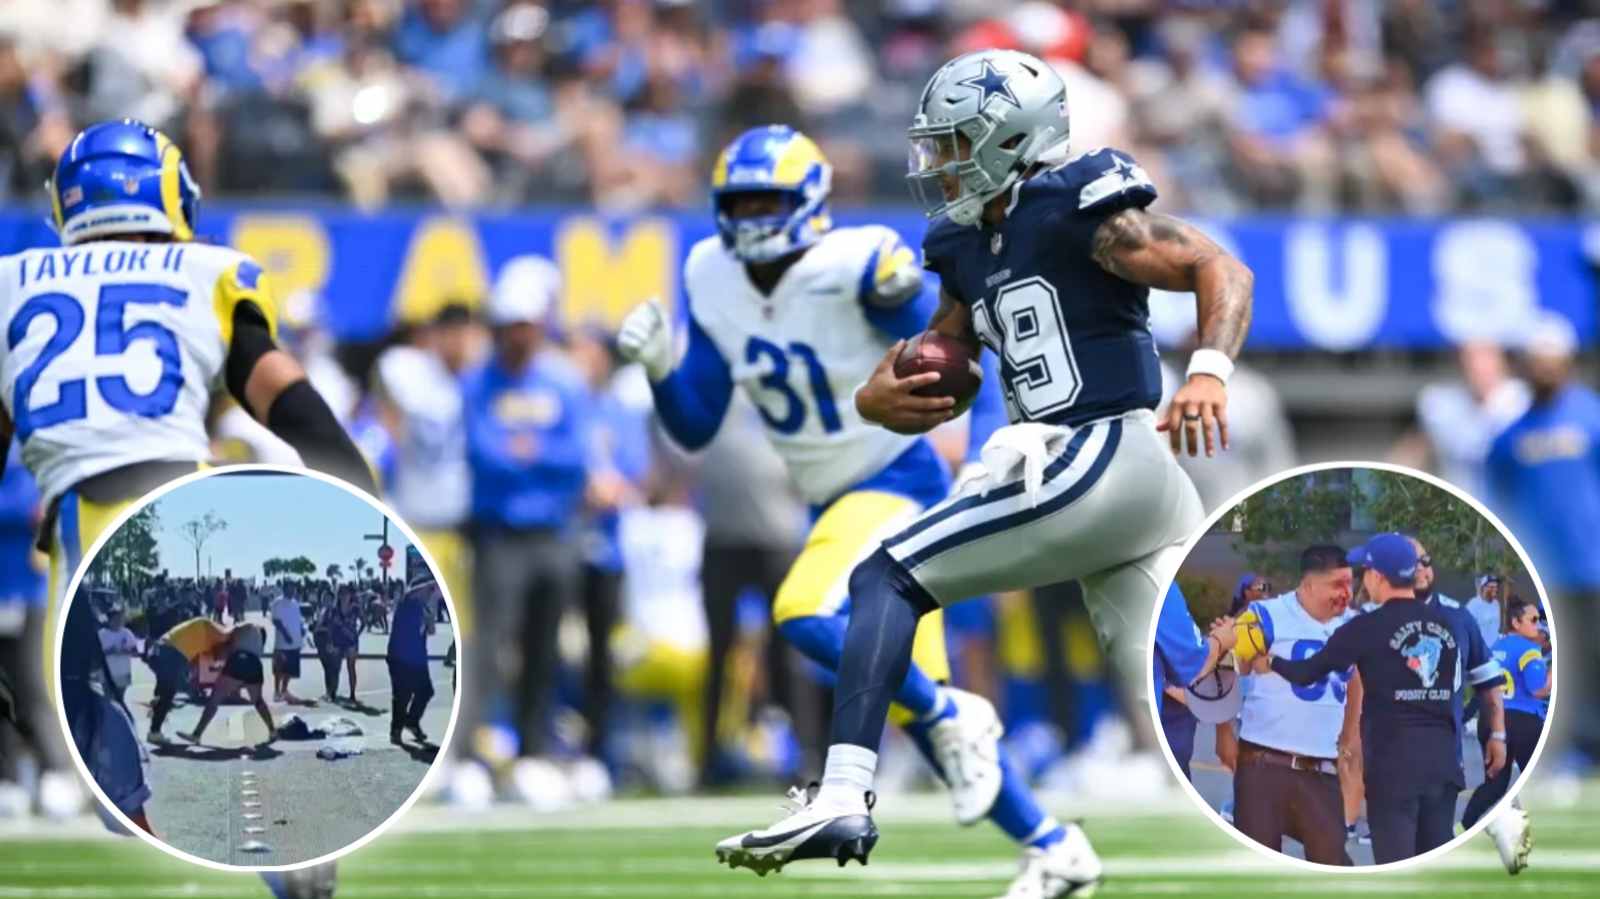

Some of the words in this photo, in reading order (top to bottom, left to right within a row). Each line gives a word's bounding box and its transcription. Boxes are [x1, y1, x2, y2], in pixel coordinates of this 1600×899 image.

[19, 248, 150, 288] TAYLOR
[163, 246, 184, 273] II
[7, 283, 189, 444] 25
[745, 336, 843, 435] 31
[972, 274, 1084, 425] 19
